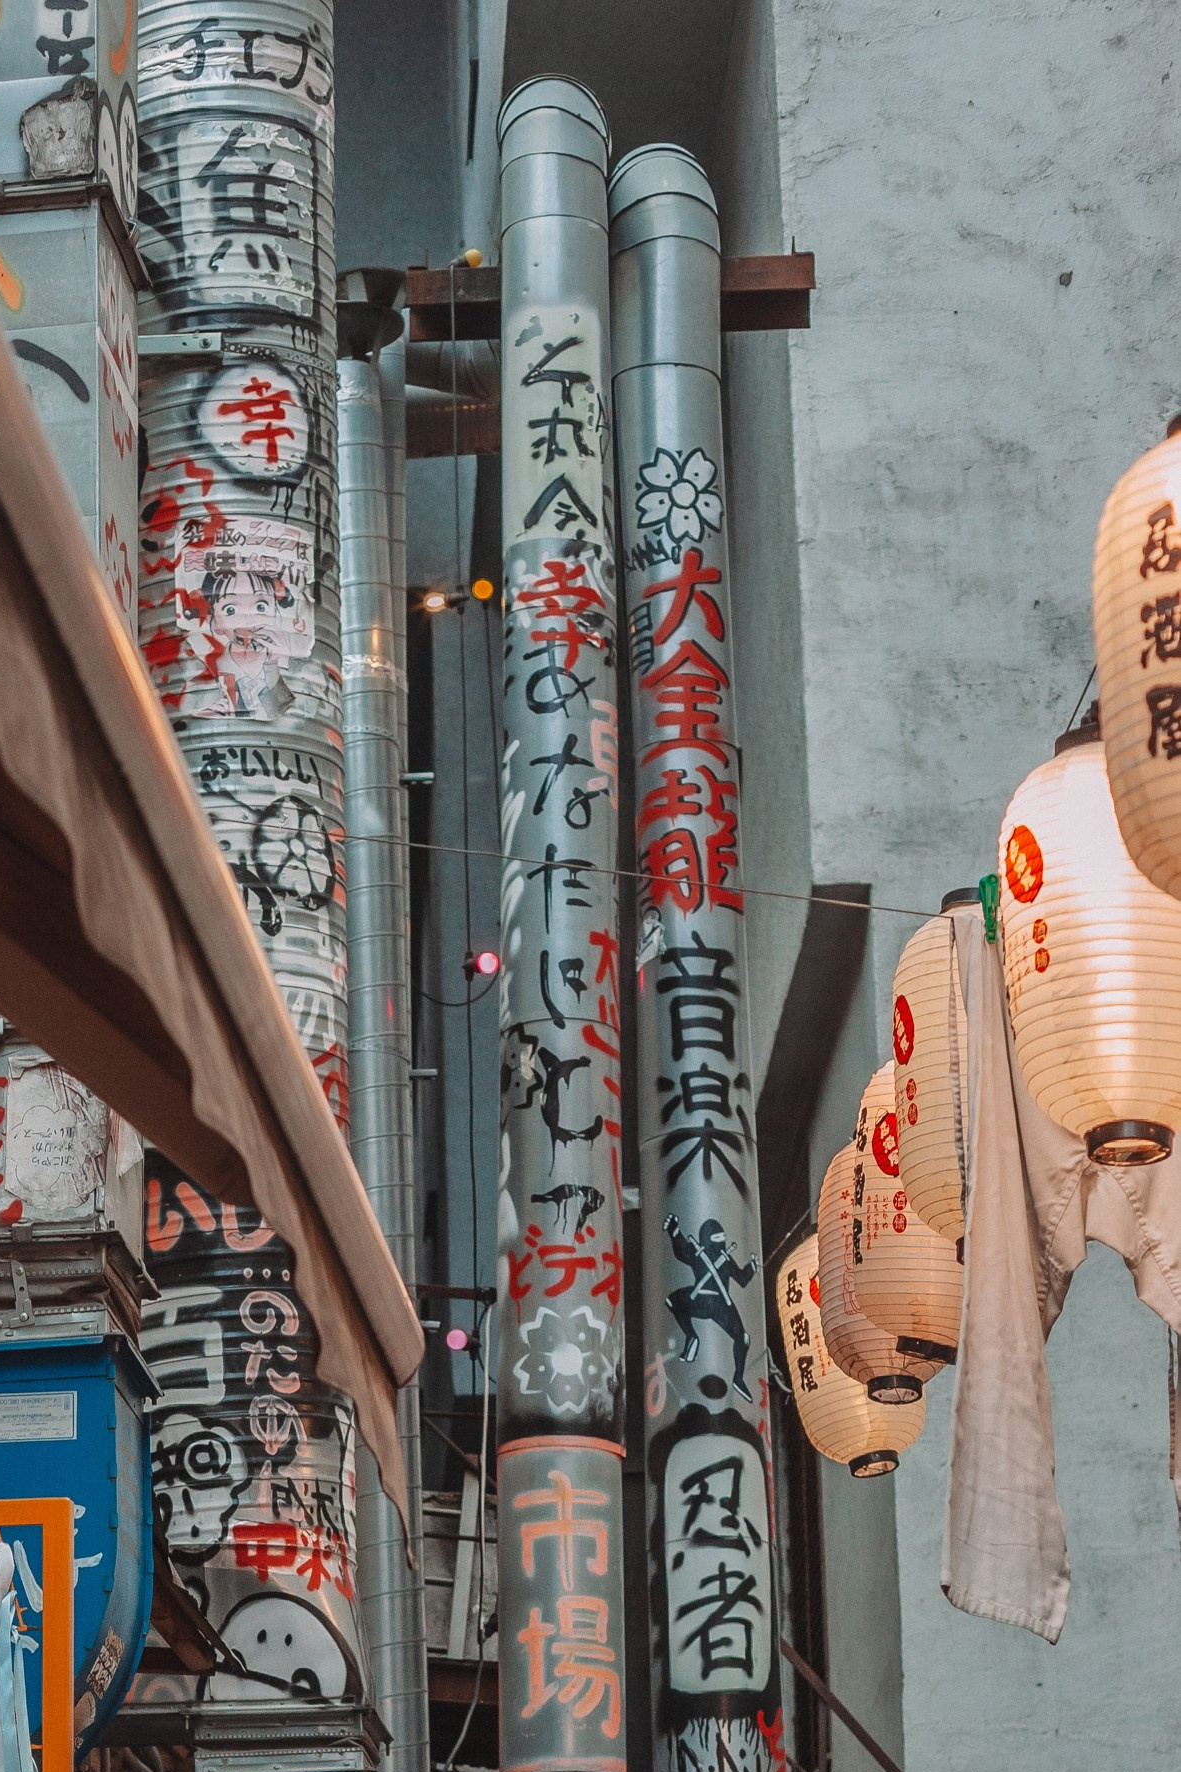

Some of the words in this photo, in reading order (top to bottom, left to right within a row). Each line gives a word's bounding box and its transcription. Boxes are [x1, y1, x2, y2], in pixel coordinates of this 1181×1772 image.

[217, 376, 293, 464] 幸
[199, 747, 324, 800] おいしい
[656, 930, 756, 1205] 音楽
[786, 1267, 819, 1393] 居酒屋
[513, 1469, 622, 1739] 市場
[676, 1456, 764, 1681] 忍者
